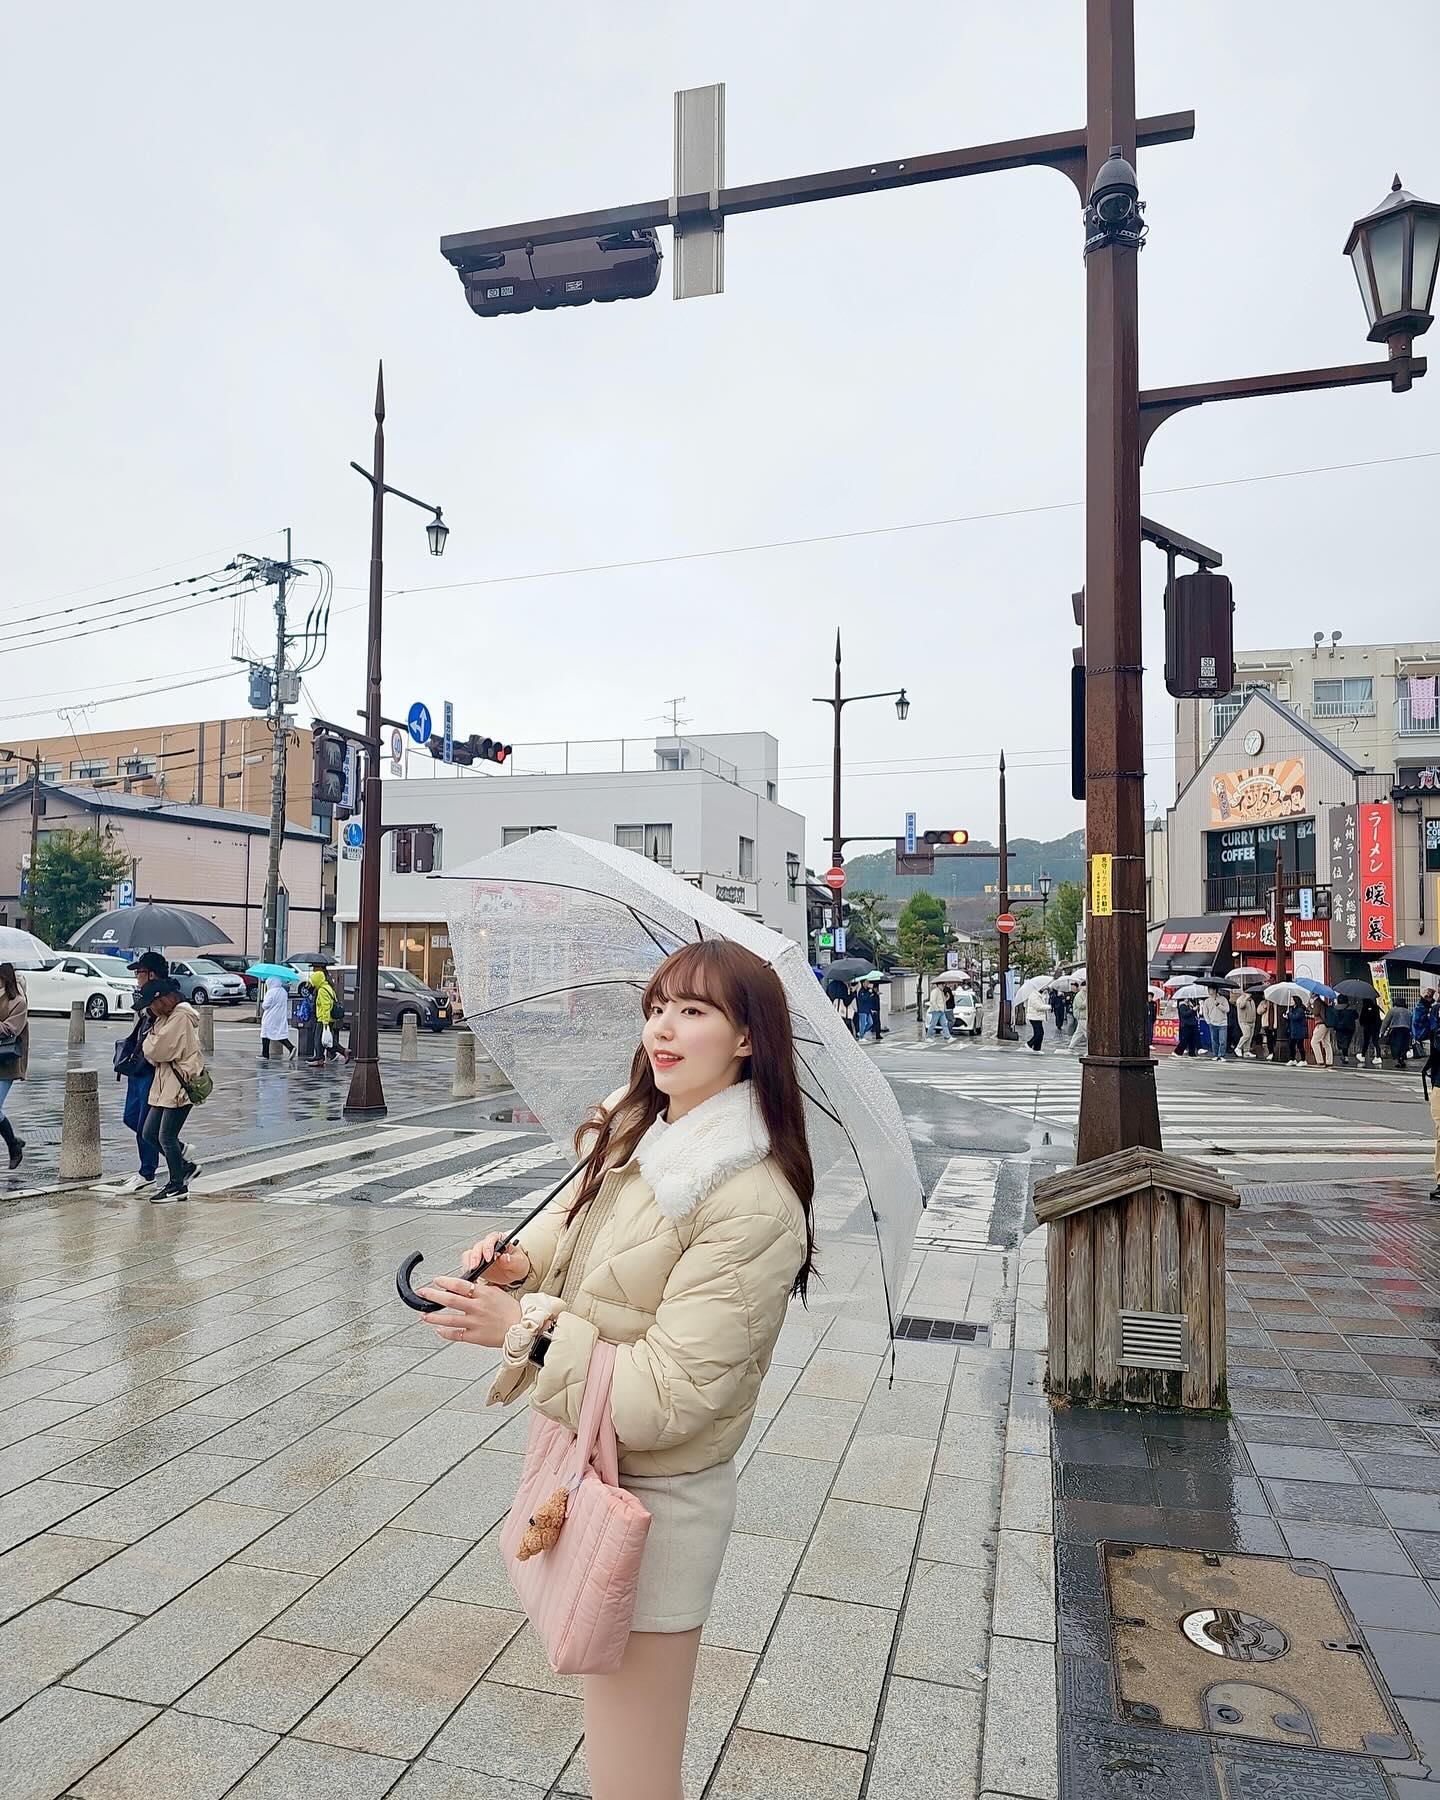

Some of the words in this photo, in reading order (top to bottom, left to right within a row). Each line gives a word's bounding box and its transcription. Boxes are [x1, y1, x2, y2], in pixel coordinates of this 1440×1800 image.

[1221, 829, 1255, 847] CURRY
[1258, 824, 1287, 843] RICE
[1368, 811, 1383, 872] ラーメン
[1221, 847, 1256, 863] COFFEE
[1332, 836, 1342, 879] 第一位
[1344, 814, 1357, 942] 九州ラーメン総選挙
[120, 881, 131, 904] P
[1236, 931, 1256, 939] ラーメン
[1154, 1025, 1179, 1038] RROS
